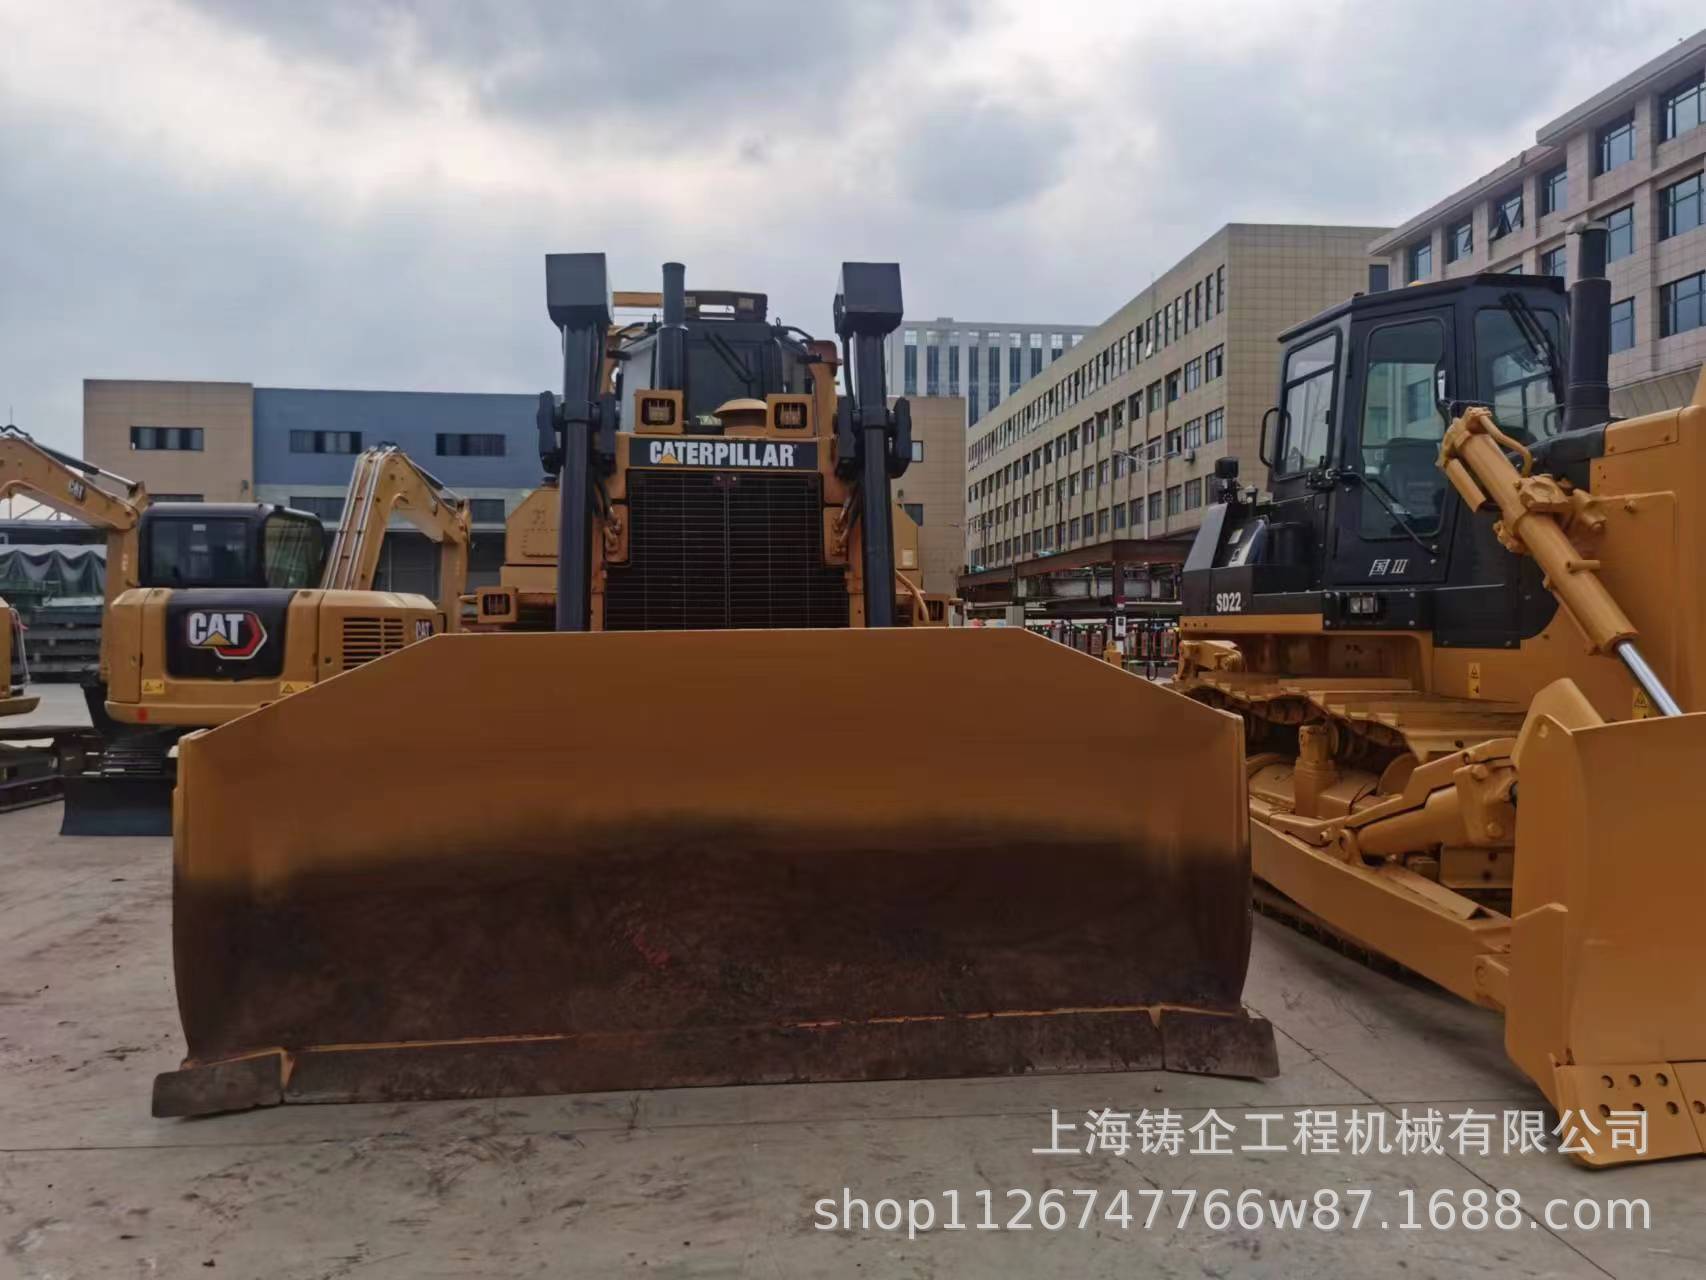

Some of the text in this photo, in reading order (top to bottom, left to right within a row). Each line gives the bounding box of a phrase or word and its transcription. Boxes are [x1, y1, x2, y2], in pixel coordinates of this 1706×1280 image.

[649, 441, 794, 467] CATERPILLAR
[1215, 592, 1242, 612] SD22
[189, 612, 244, 645] CAT
